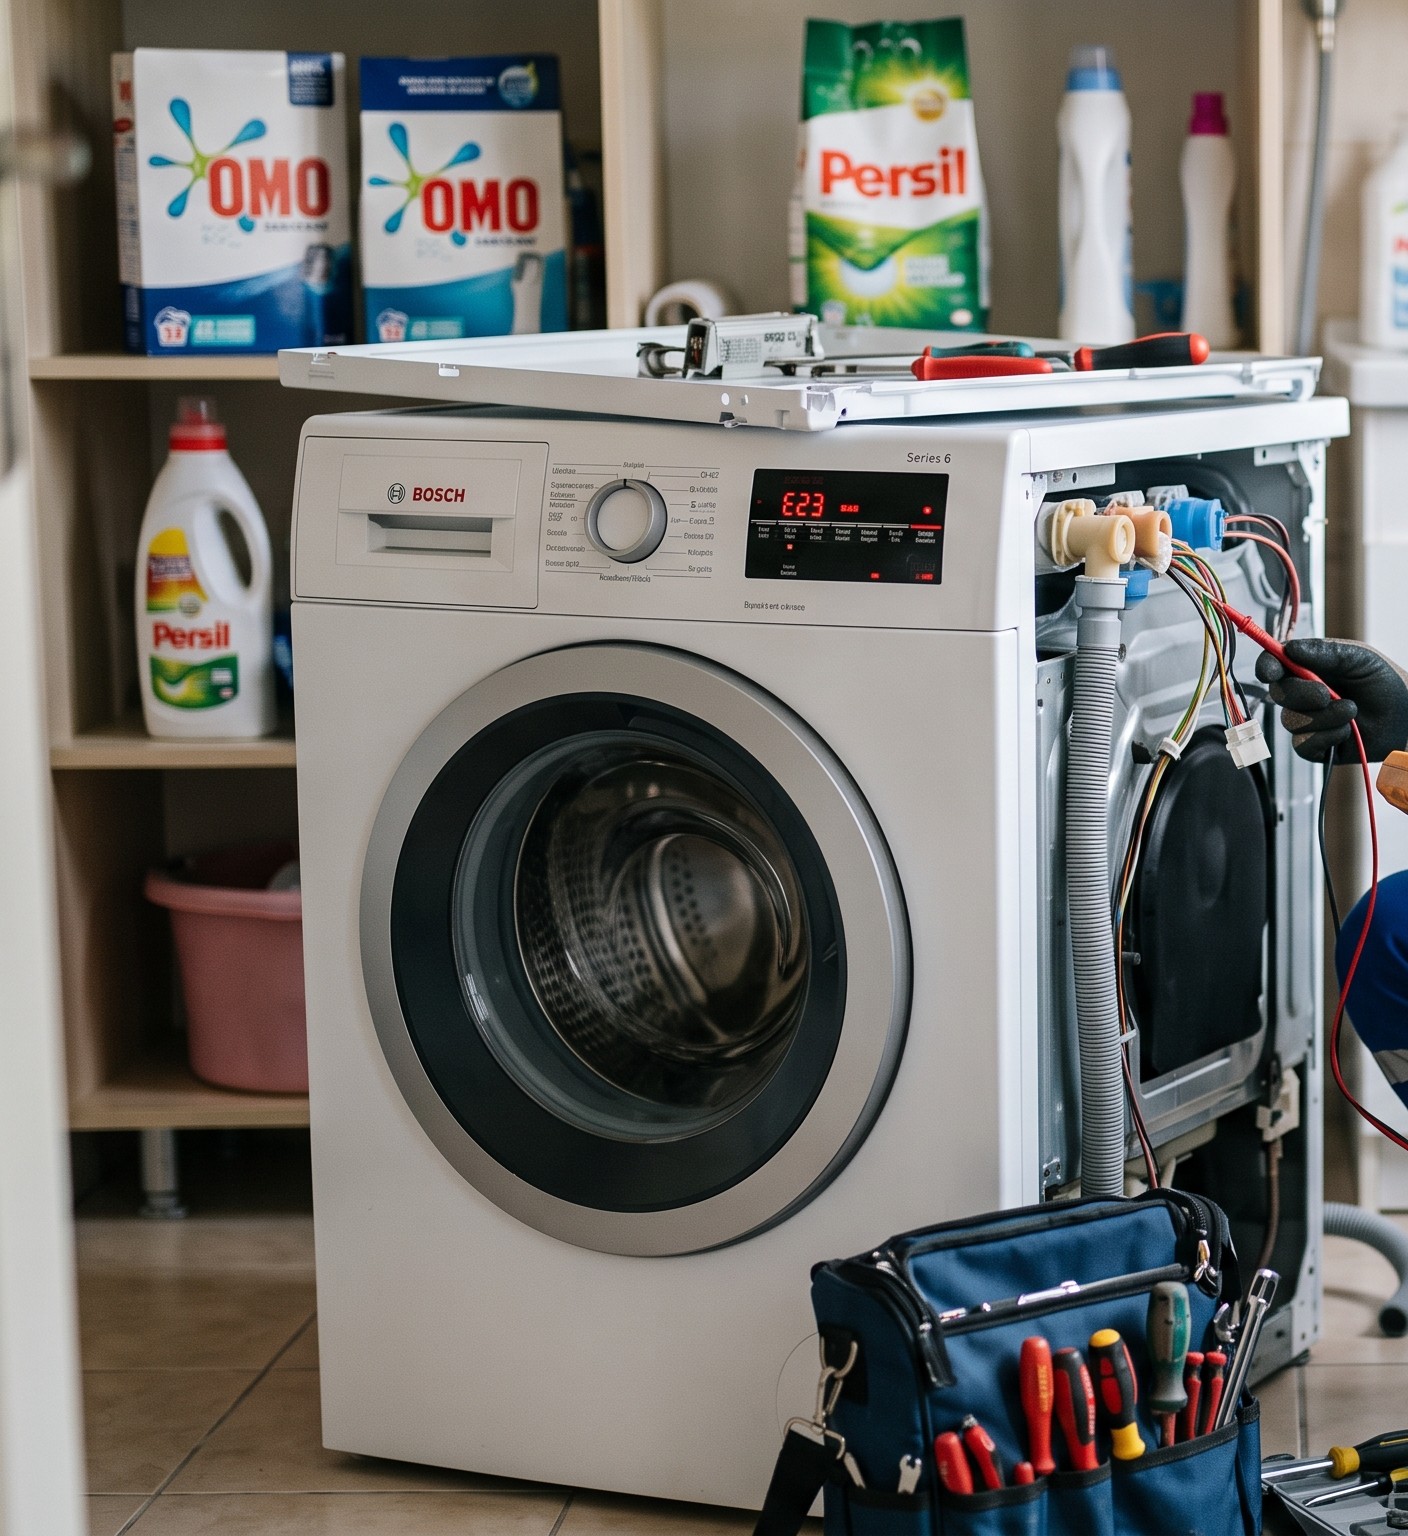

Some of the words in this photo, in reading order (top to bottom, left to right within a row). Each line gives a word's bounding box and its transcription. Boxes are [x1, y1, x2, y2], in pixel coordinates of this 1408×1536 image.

[820, 147, 966, 197] Persil
[209, 157, 331, 217] OMO
[422, 178, 539, 233] OMO
[906, 452, 941, 464] Series
[944, 453, 952, 464] 6
[412, 487, 466, 503] BOSCH
[782, 492, 825, 517] E23
[153, 621, 230, 649] Persil
